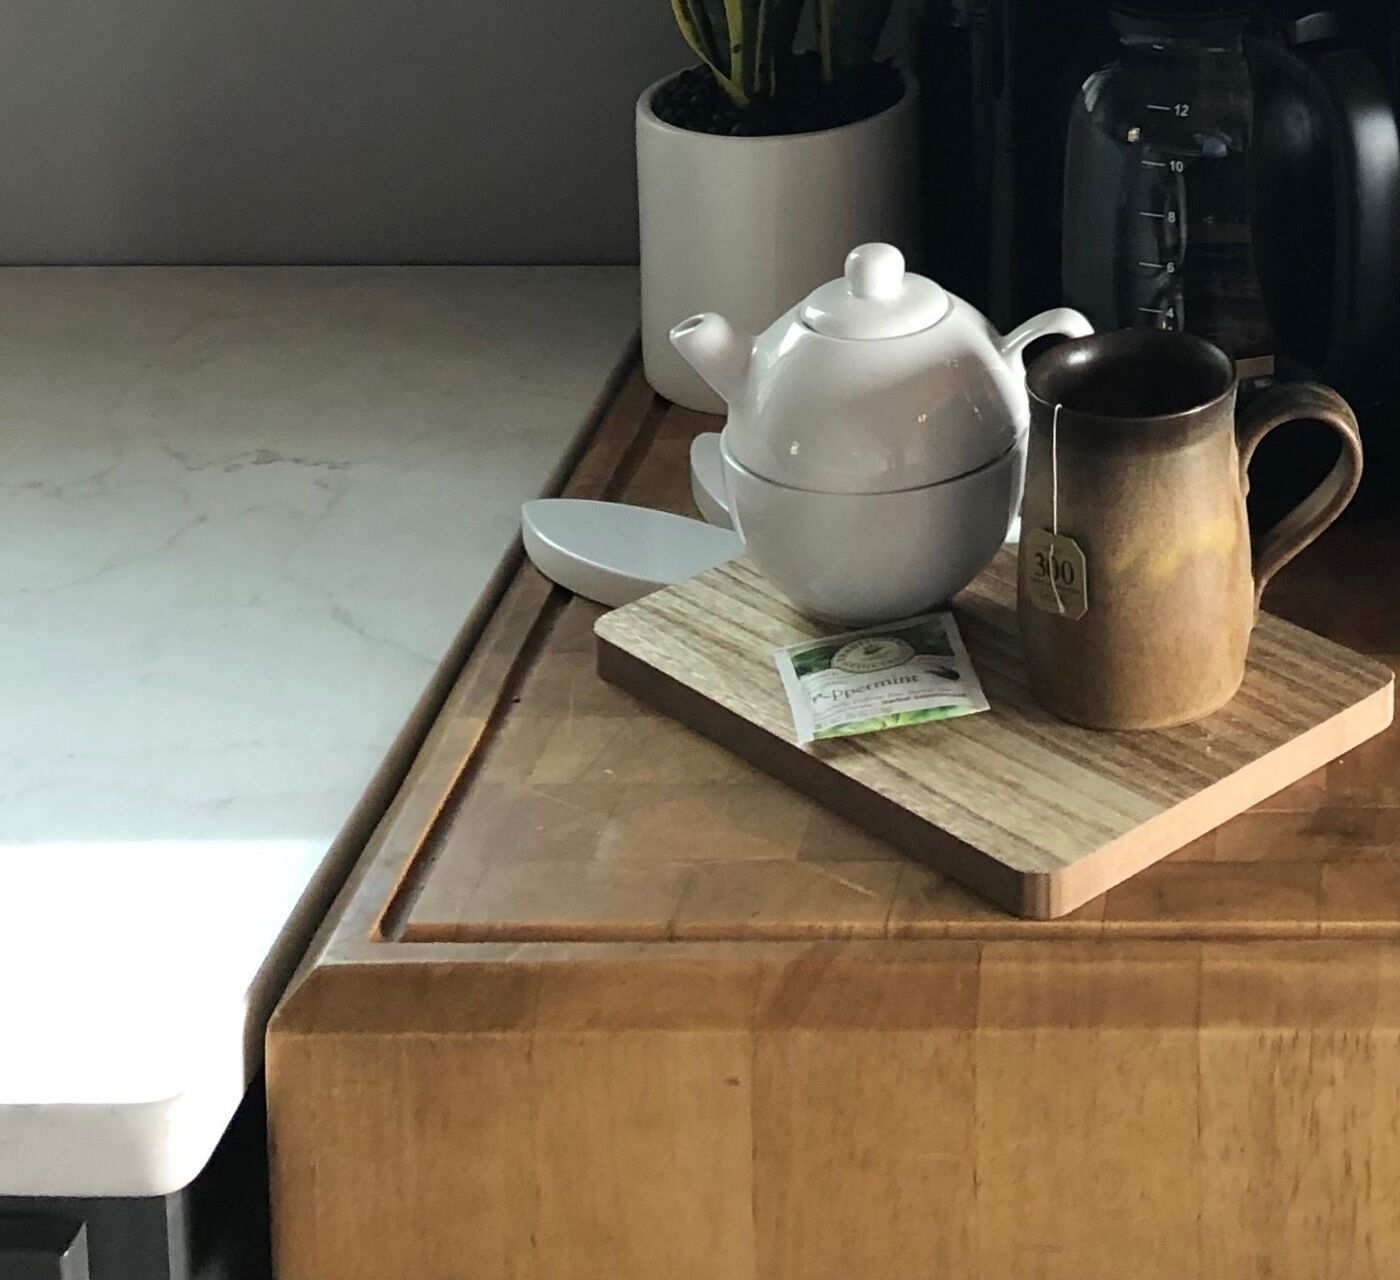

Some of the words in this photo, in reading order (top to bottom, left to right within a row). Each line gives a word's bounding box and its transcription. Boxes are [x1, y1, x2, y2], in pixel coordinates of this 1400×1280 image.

[1173, 103, 1190, 117] 12
[1169, 160, 1184, 173] 10
[1167, 211, 1176, 223] 8
[1166, 262, 1175, 273] 6
[1165, 307, 1174, 319] 4
[1034, 551, 1075, 586] 300
